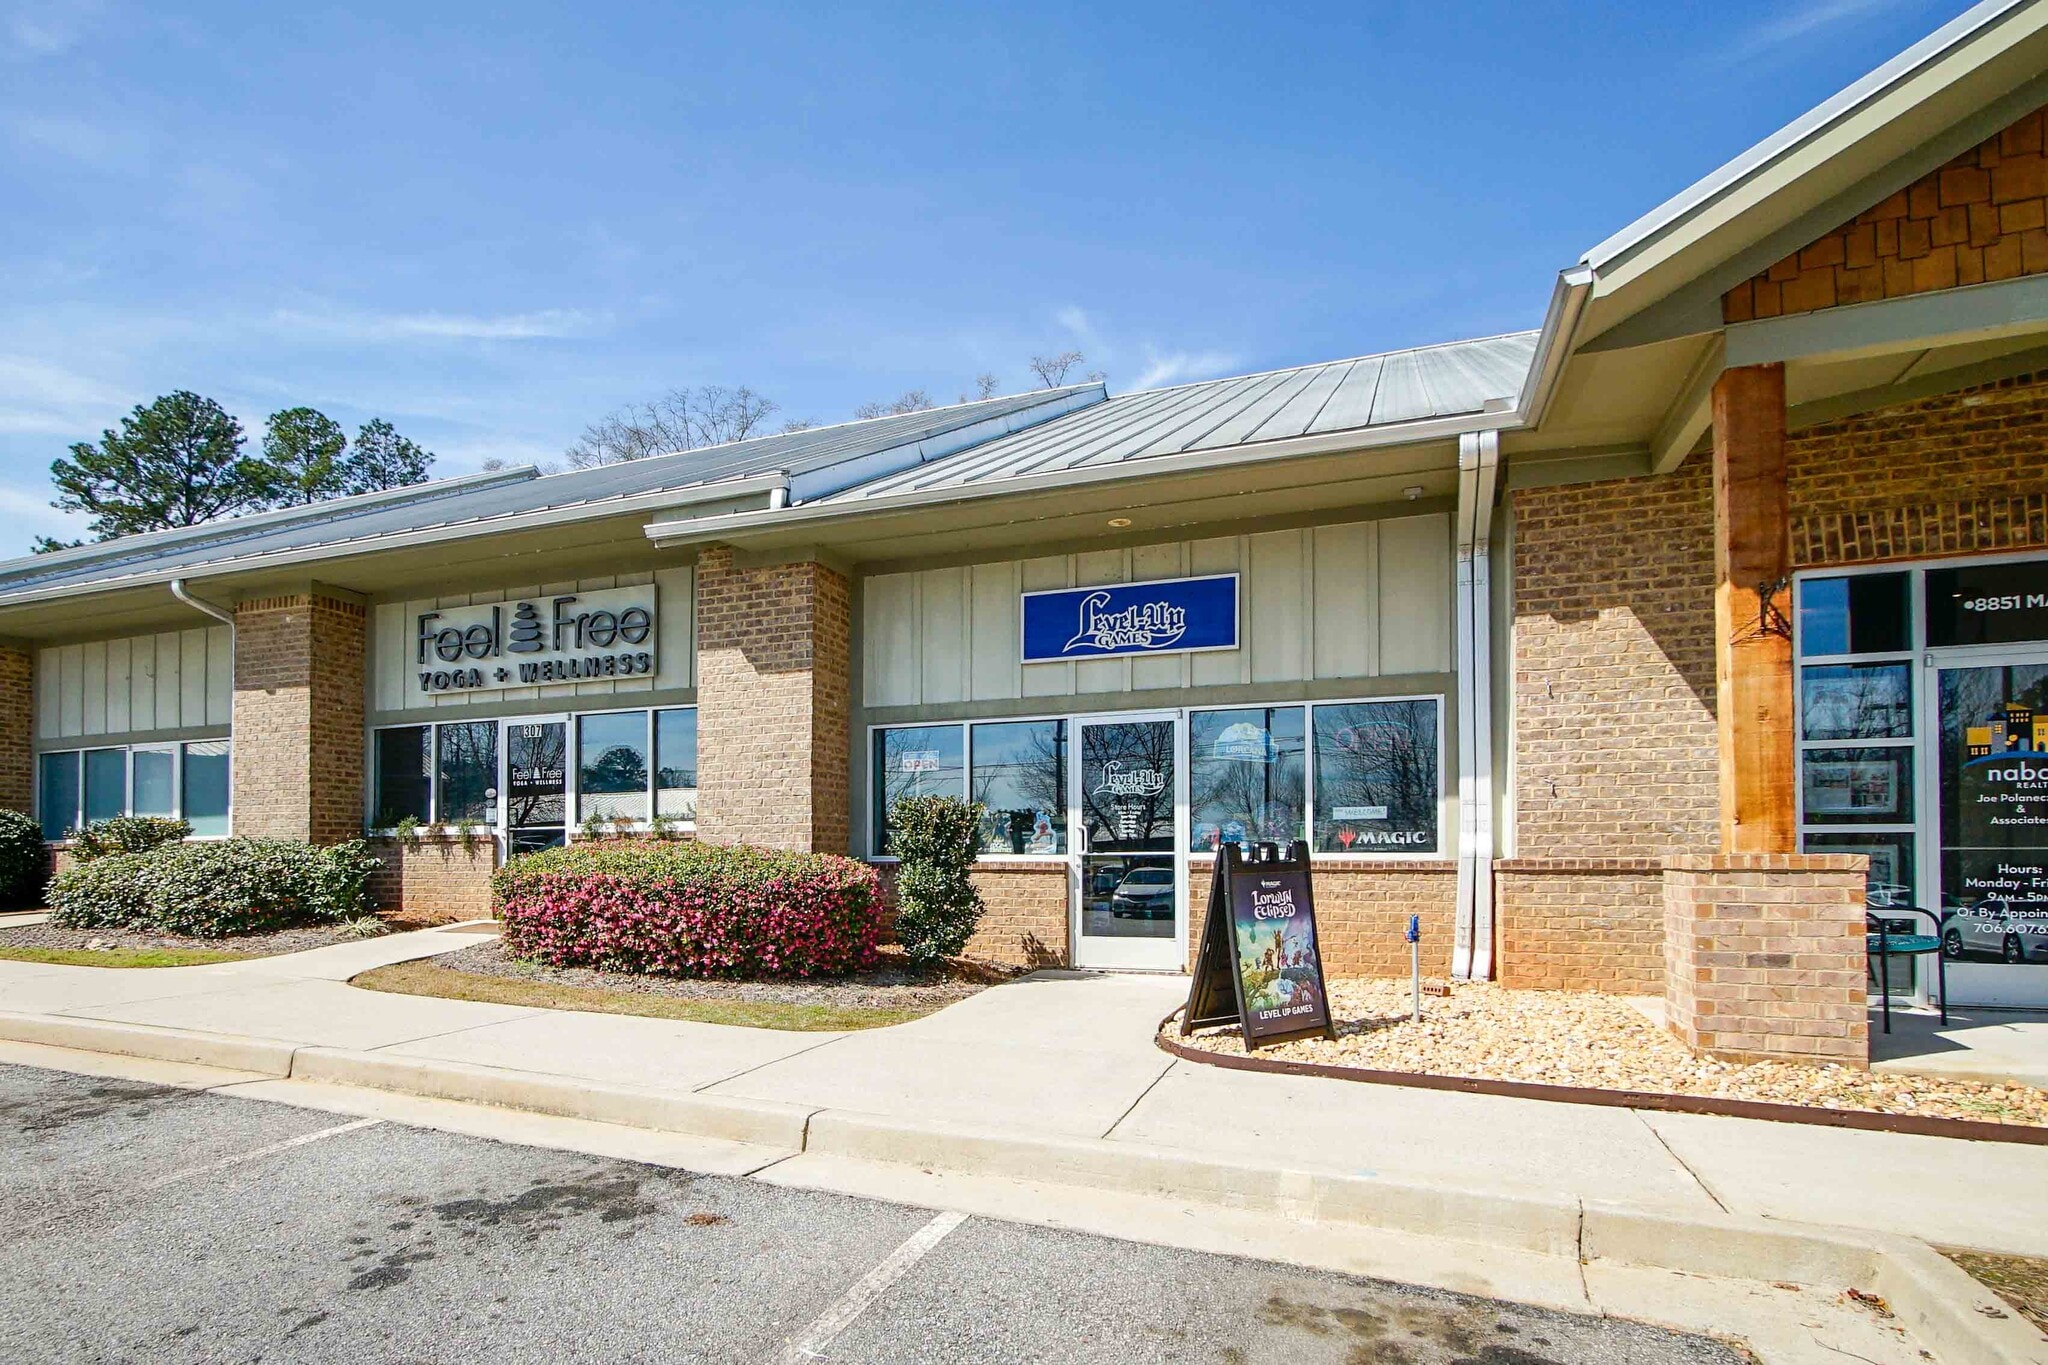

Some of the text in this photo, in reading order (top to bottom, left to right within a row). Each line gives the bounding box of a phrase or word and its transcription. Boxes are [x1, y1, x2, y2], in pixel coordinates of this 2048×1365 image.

[1974, 593, 2048, 611] 8851 M
[416, 596, 651, 665] Feel Free
[1096, 630, 1150, 649] GAMES
[417, 667, 483, 692] YOGA
[518, 652, 652, 683] WELLNESS
[524, 725, 541, 738] 307
[904, 760, 938, 770] OPEN
[512, 766, 563, 780] Feel Free
[1976, 793, 2048, 803] Joe Polanec
[2016, 804, 2026, 814] &
[1356, 831, 1427, 845] MAGIC
[1998, 863, 2043, 874] Hours:
[1965, 877, 2020, 890] Monday
[1957, 907, 1975, 918] Or
[1979, 907, 1995, 919] By
[1973, 923, 2048, 934] 706.607.6
[1260, 1004, 1314, 1020] LEVEL UP GAMES
